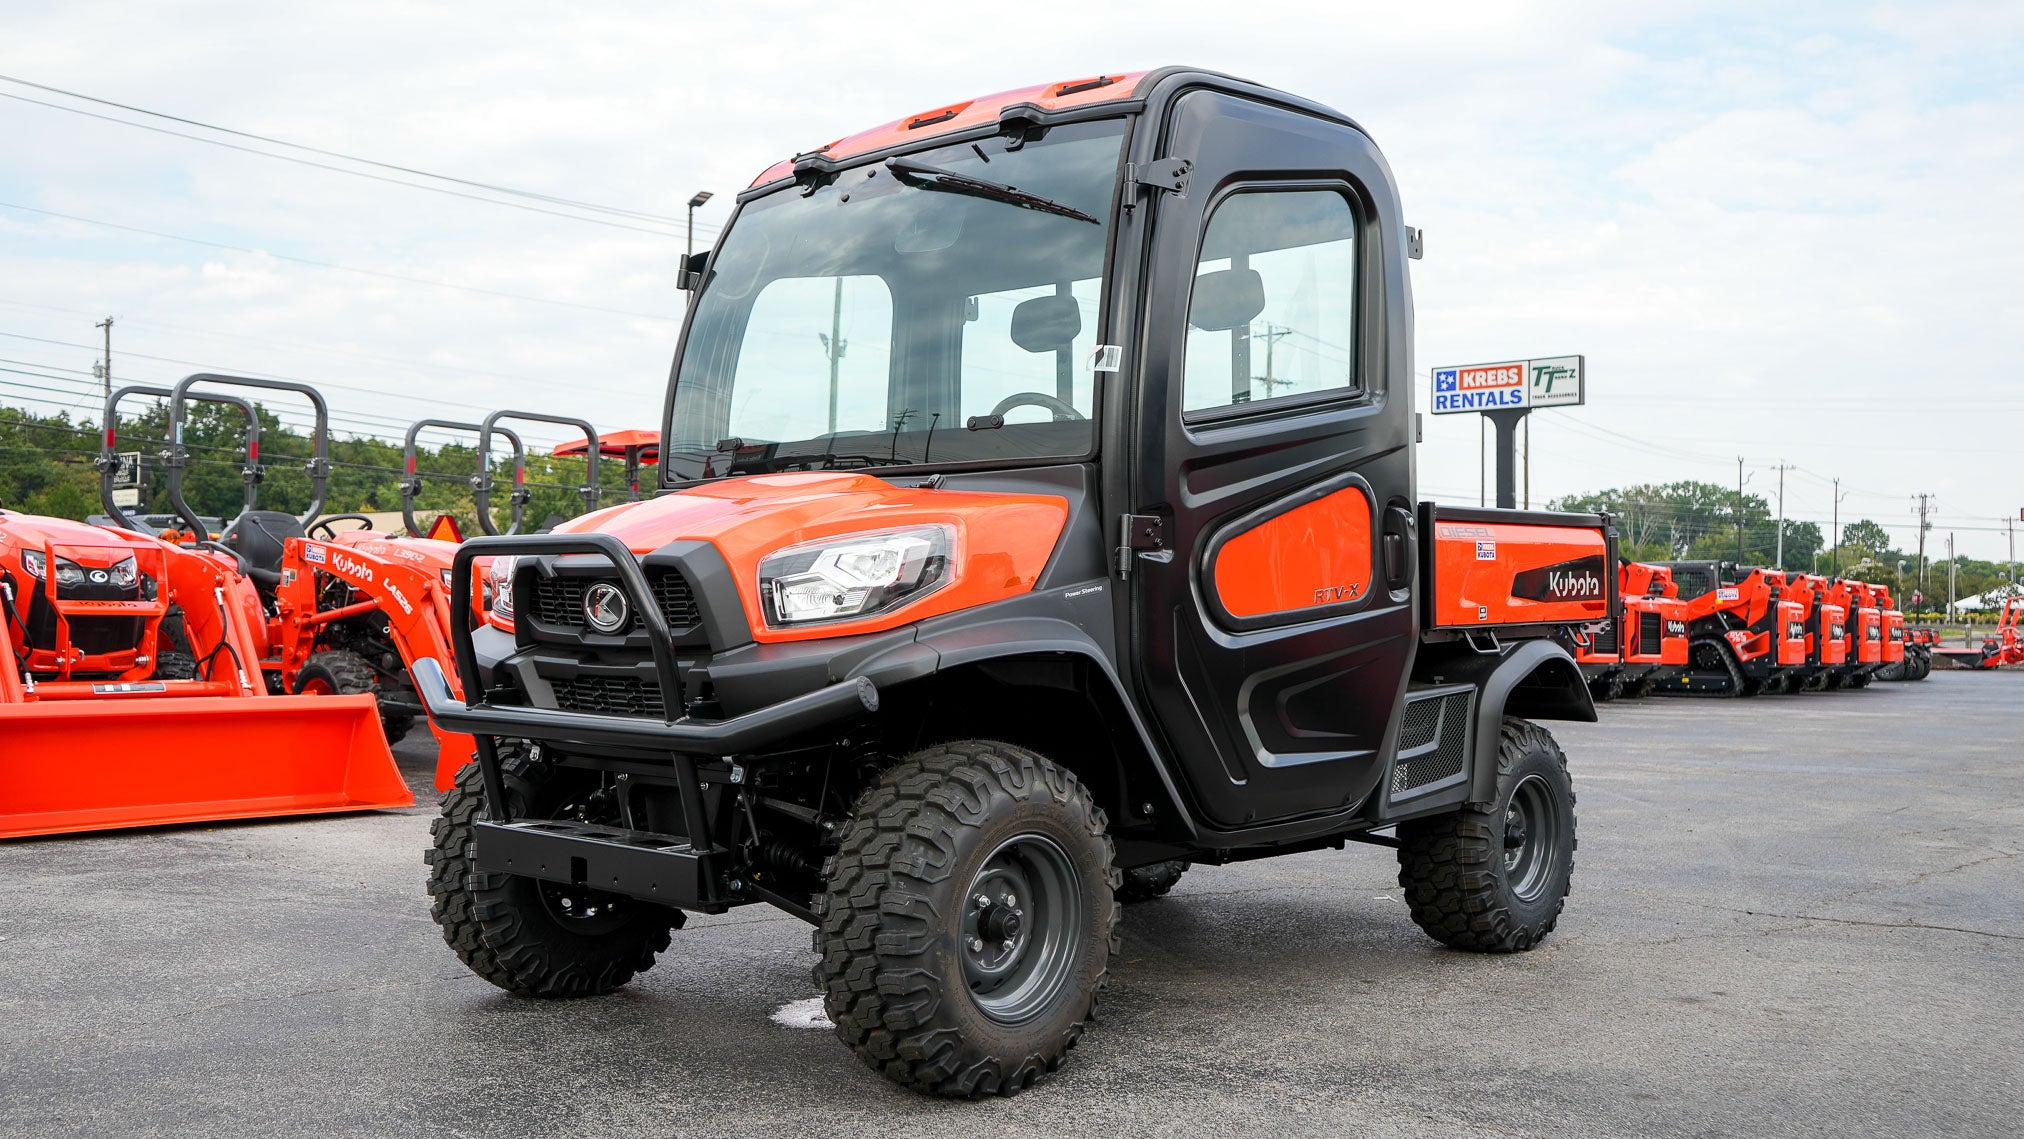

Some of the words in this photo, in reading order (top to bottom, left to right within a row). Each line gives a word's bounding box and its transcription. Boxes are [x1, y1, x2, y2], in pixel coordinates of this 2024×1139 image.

[1462, 367, 1519, 388] KREBS
[1436, 389, 1523, 410] RENTALS
[1440, 526, 1495, 538] DIESEL
[394, 549, 425, 563] L3902
[332, 552, 373, 582] Kubota
[383, 577, 414, 615] LA526
[1081, 585, 1103, 595] Steering
[1313, 583, 1360, 603] RTV-X
[1550, 570, 1600, 597] Kubota
